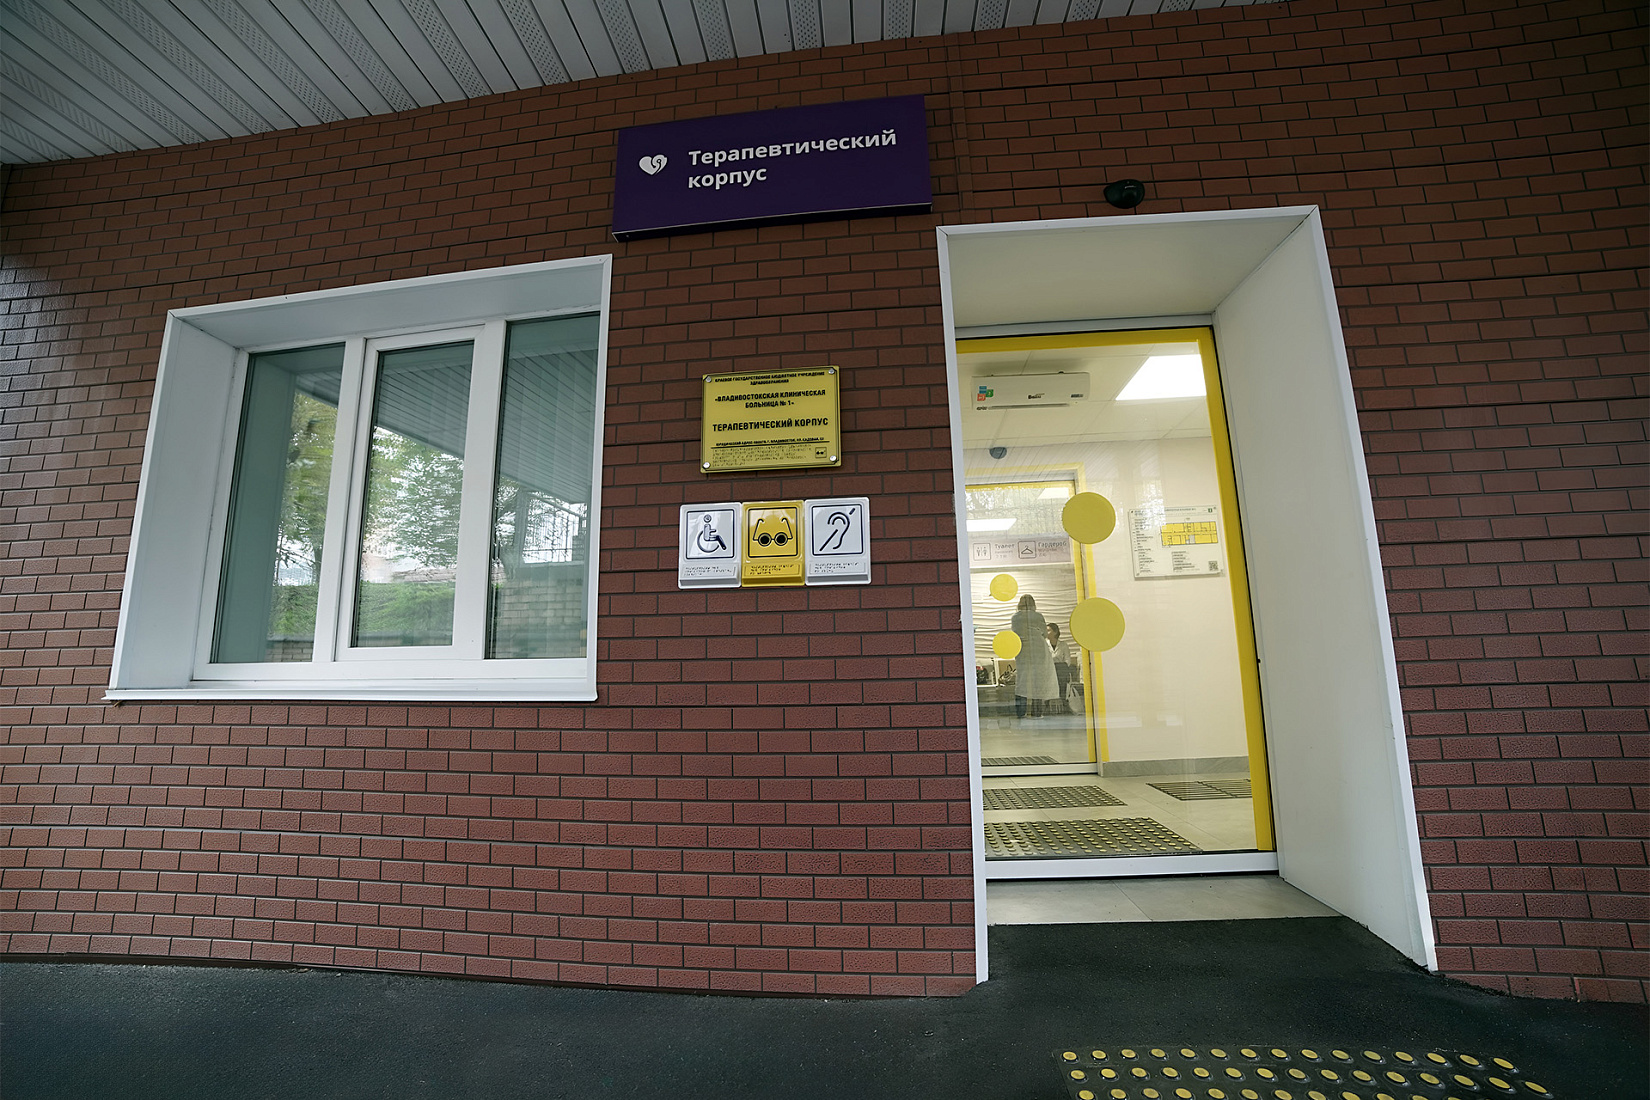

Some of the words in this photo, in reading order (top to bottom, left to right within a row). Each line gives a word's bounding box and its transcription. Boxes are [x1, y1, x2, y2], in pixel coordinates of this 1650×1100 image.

[688, 129, 897, 166] Терапевтический
[687, 167, 767, 190] корпус
[780, 389, 826, 399] КЛИНИЧЕСКАЯ
[745, 401, 779, 409] БОЛЬНИЦА
[712, 418, 792, 432] ТЕРАПЕВТИЧЕСКИЙ
[794, 417, 829, 427] КОРПУС
